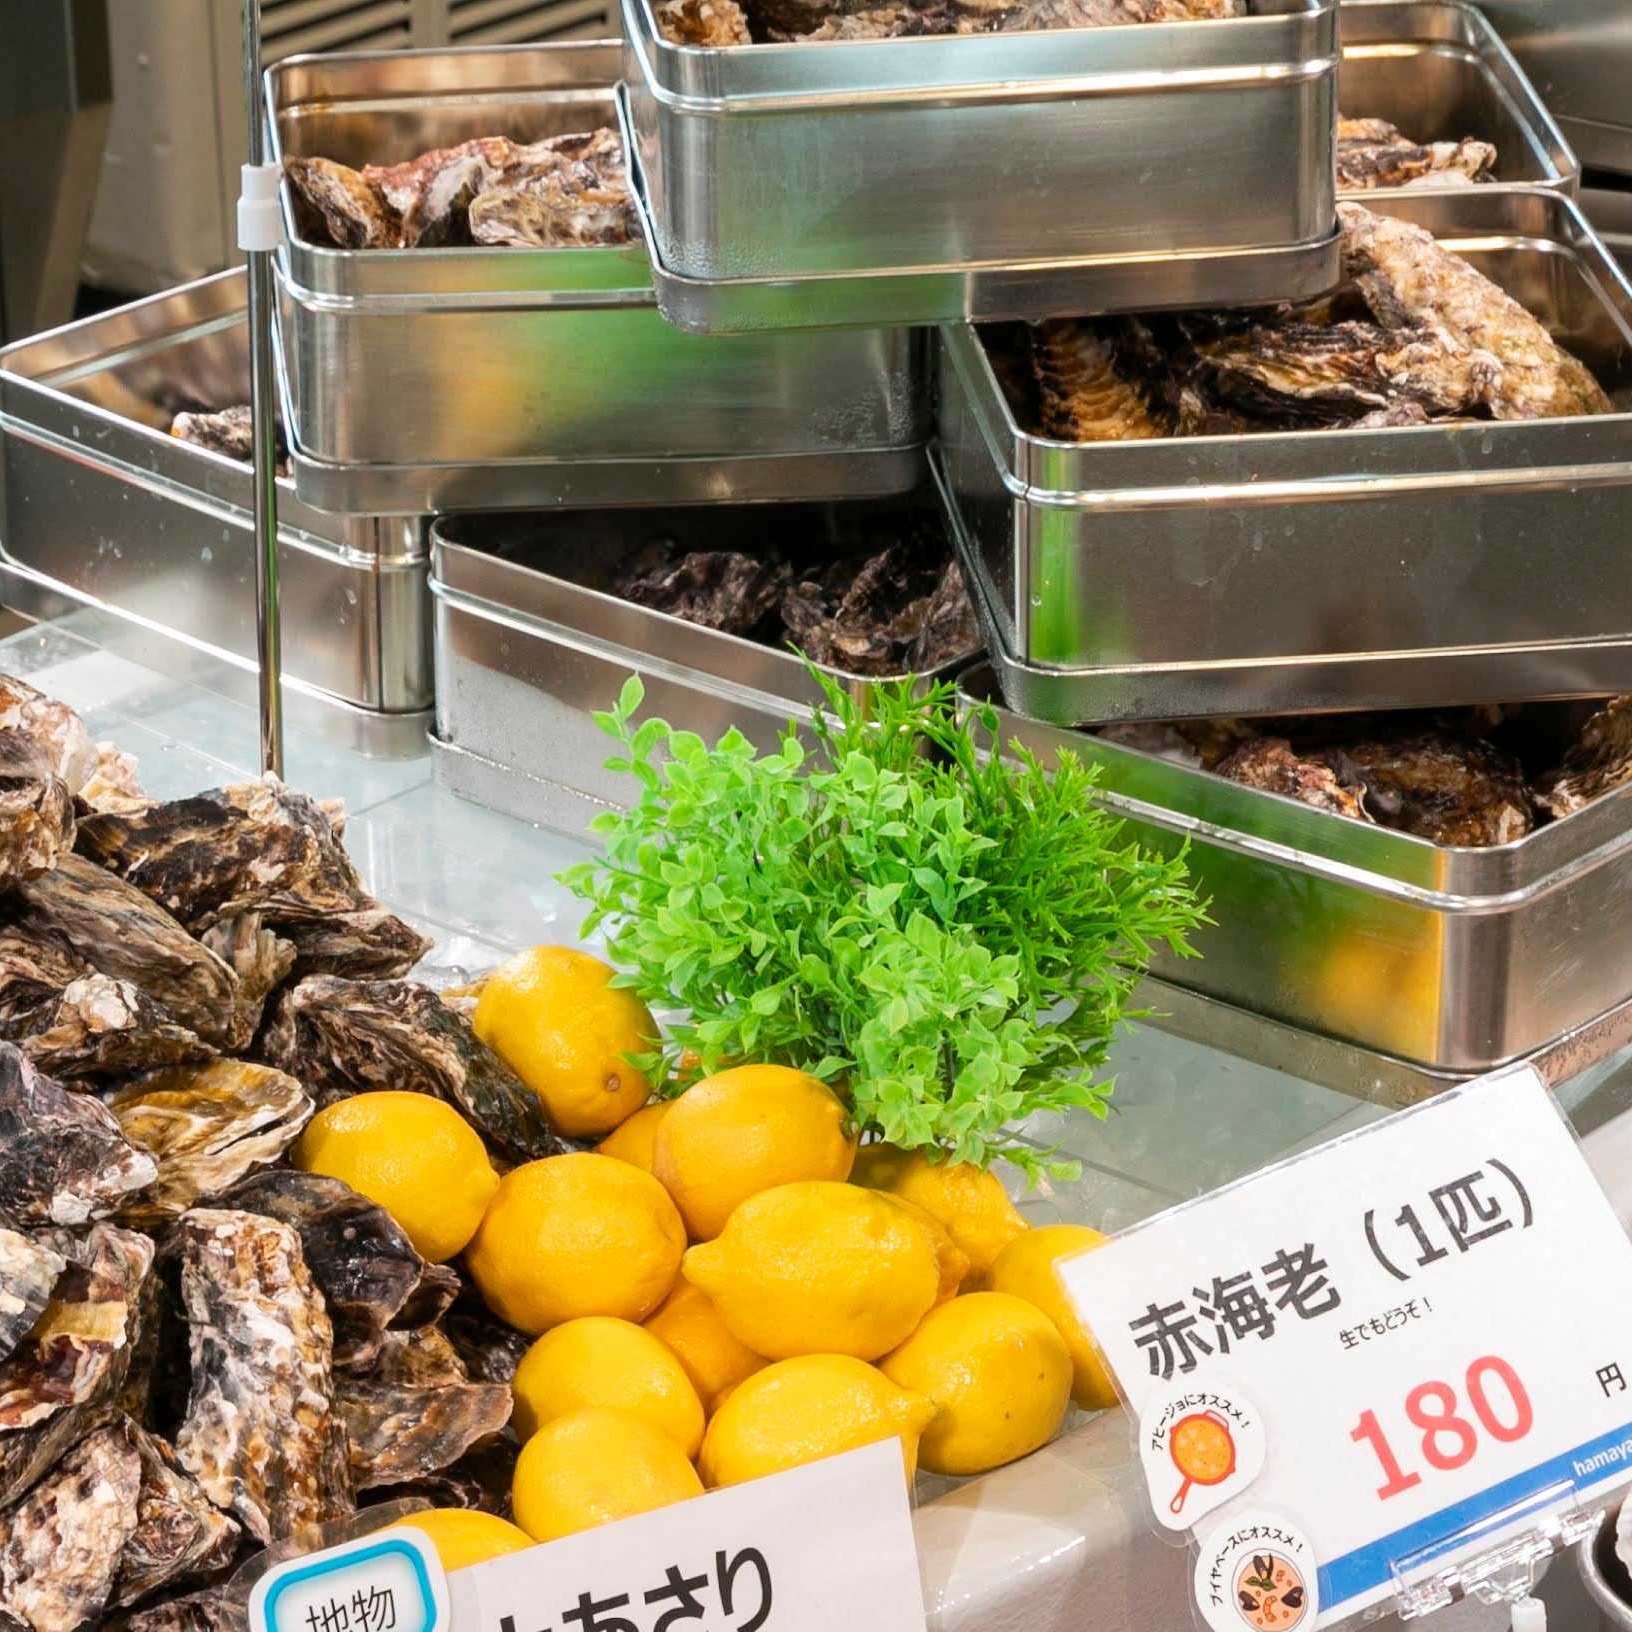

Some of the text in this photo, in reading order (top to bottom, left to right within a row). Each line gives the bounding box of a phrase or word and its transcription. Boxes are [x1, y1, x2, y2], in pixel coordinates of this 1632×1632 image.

[1339, 1299, 1434, 1351] 生でもどうぞ！
[1151, 1392, 1251, 1451] アヒージョにオススメ！
[1349, 1353, 1628, 1500] 180 円
